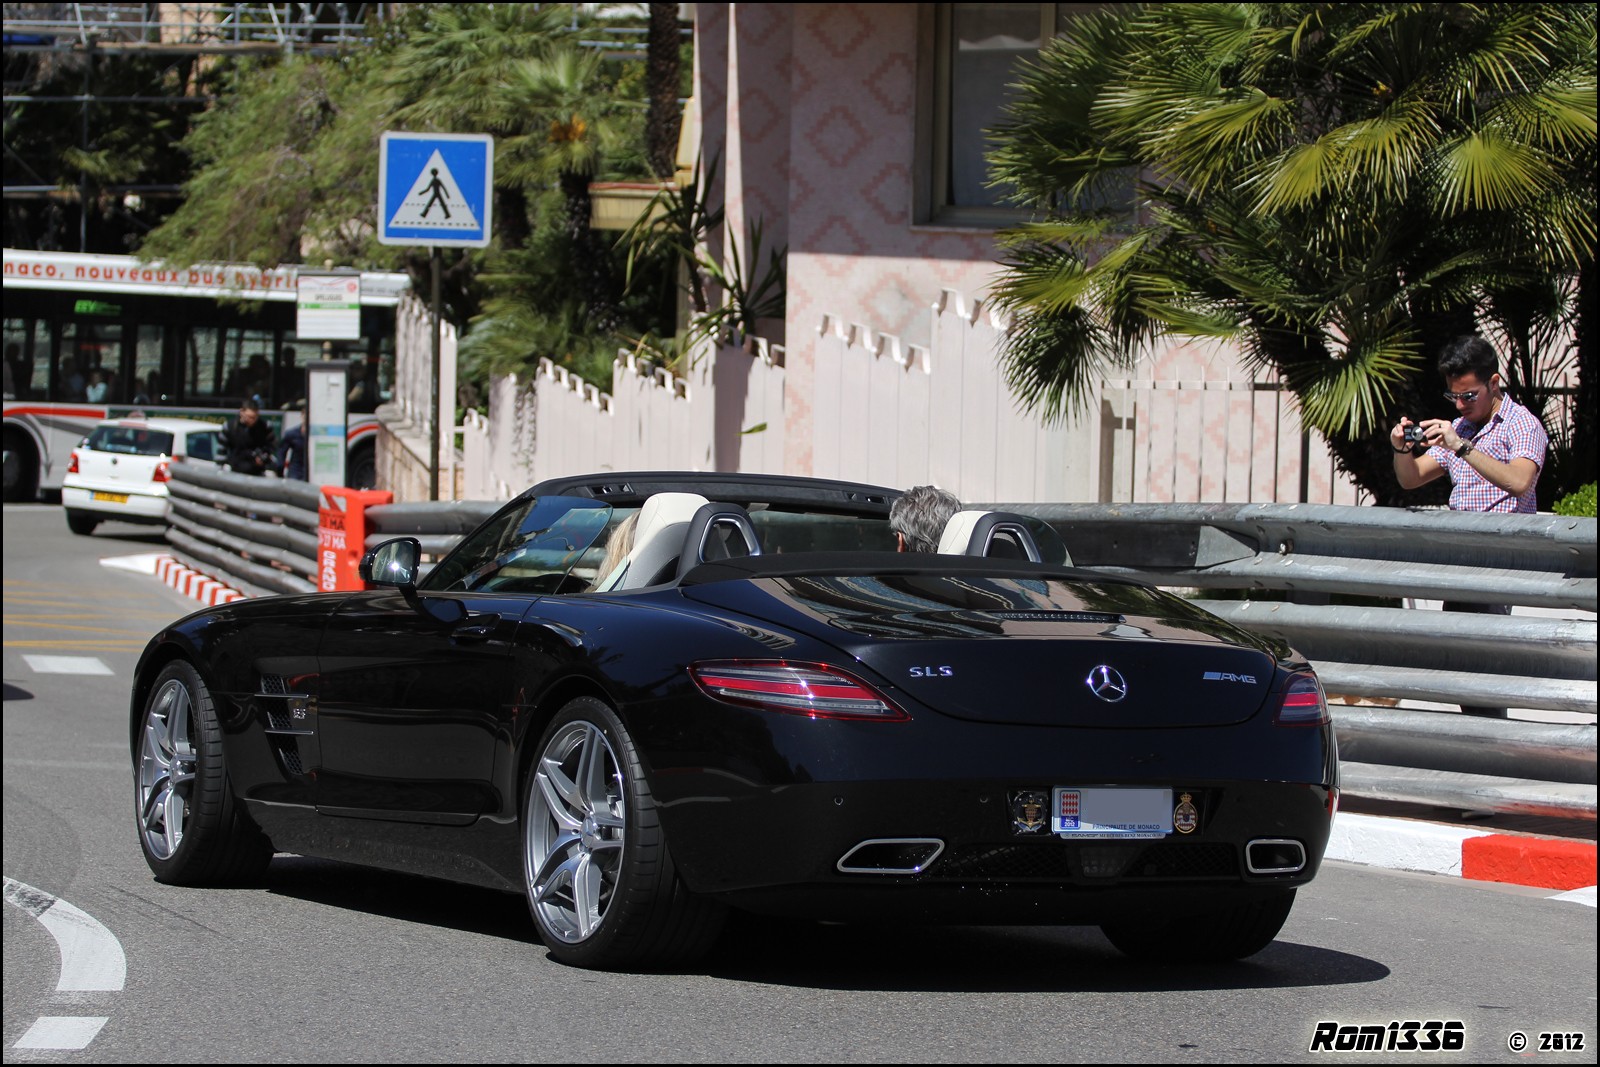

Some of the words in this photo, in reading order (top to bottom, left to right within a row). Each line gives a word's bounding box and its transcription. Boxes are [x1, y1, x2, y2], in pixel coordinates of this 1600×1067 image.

[75, 265, 178, 283] nouveaux
[188, 269, 225, 285] bus
[236, 271, 298, 291] hybri
[909, 665, 953, 677] SLS
[1220, 672, 1257, 684] AMG
[1092, 823, 1128, 831] PRINCIPAUTE
